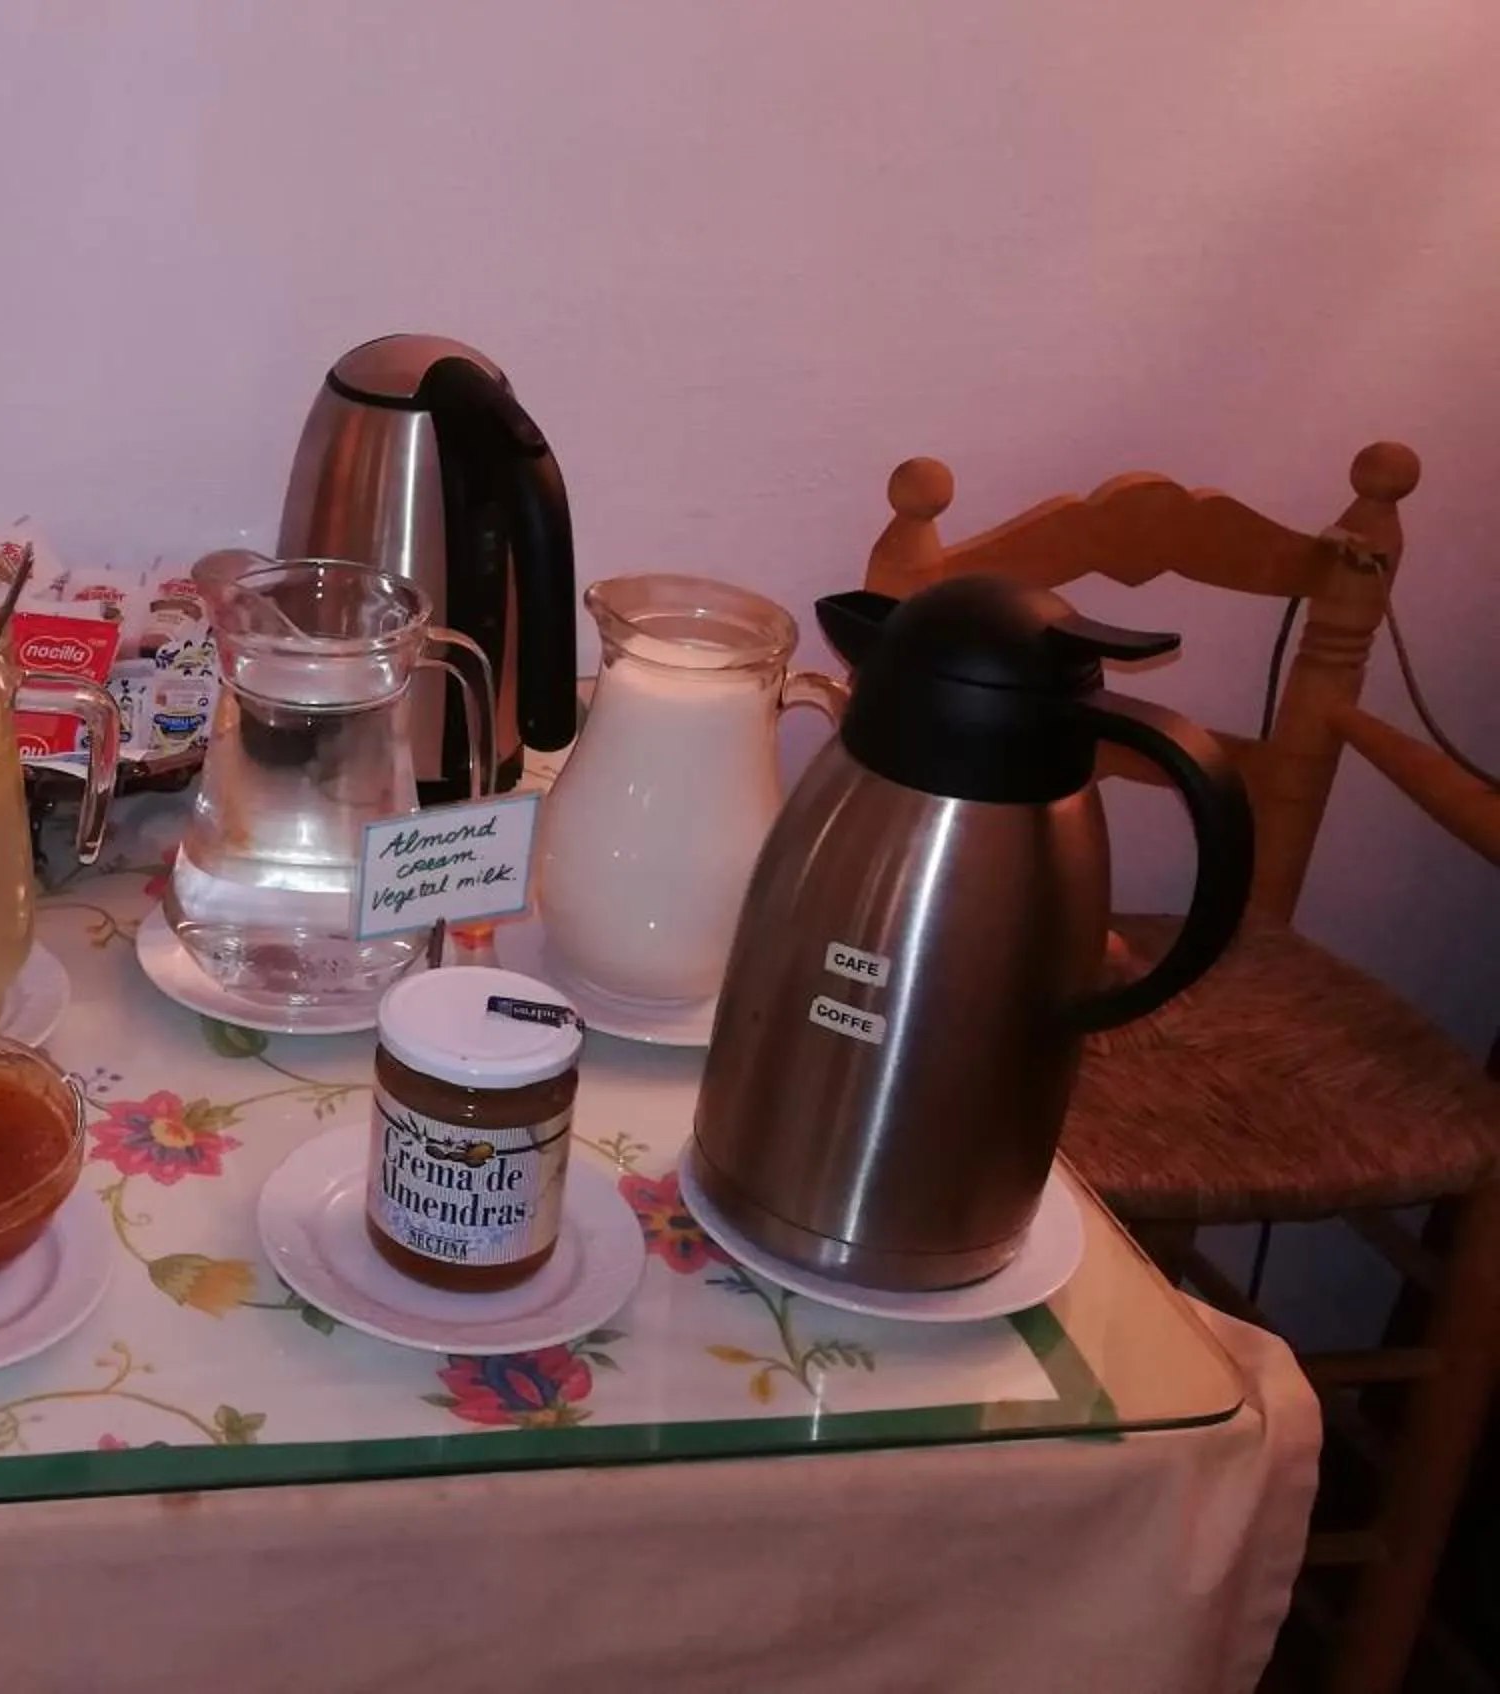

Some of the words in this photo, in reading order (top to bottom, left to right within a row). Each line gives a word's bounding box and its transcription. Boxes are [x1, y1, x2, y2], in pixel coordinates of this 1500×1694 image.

[26, 643, 86, 663] nocilla
[379, 815, 498, 859] Almond
[833, 952, 881, 977] CAFE
[816, 1003, 874, 1034] COFFE
[384, 1125, 473, 1192] Crema
[485, 1157, 524, 1193] de
[382, 1157, 527, 1228] Almendras
